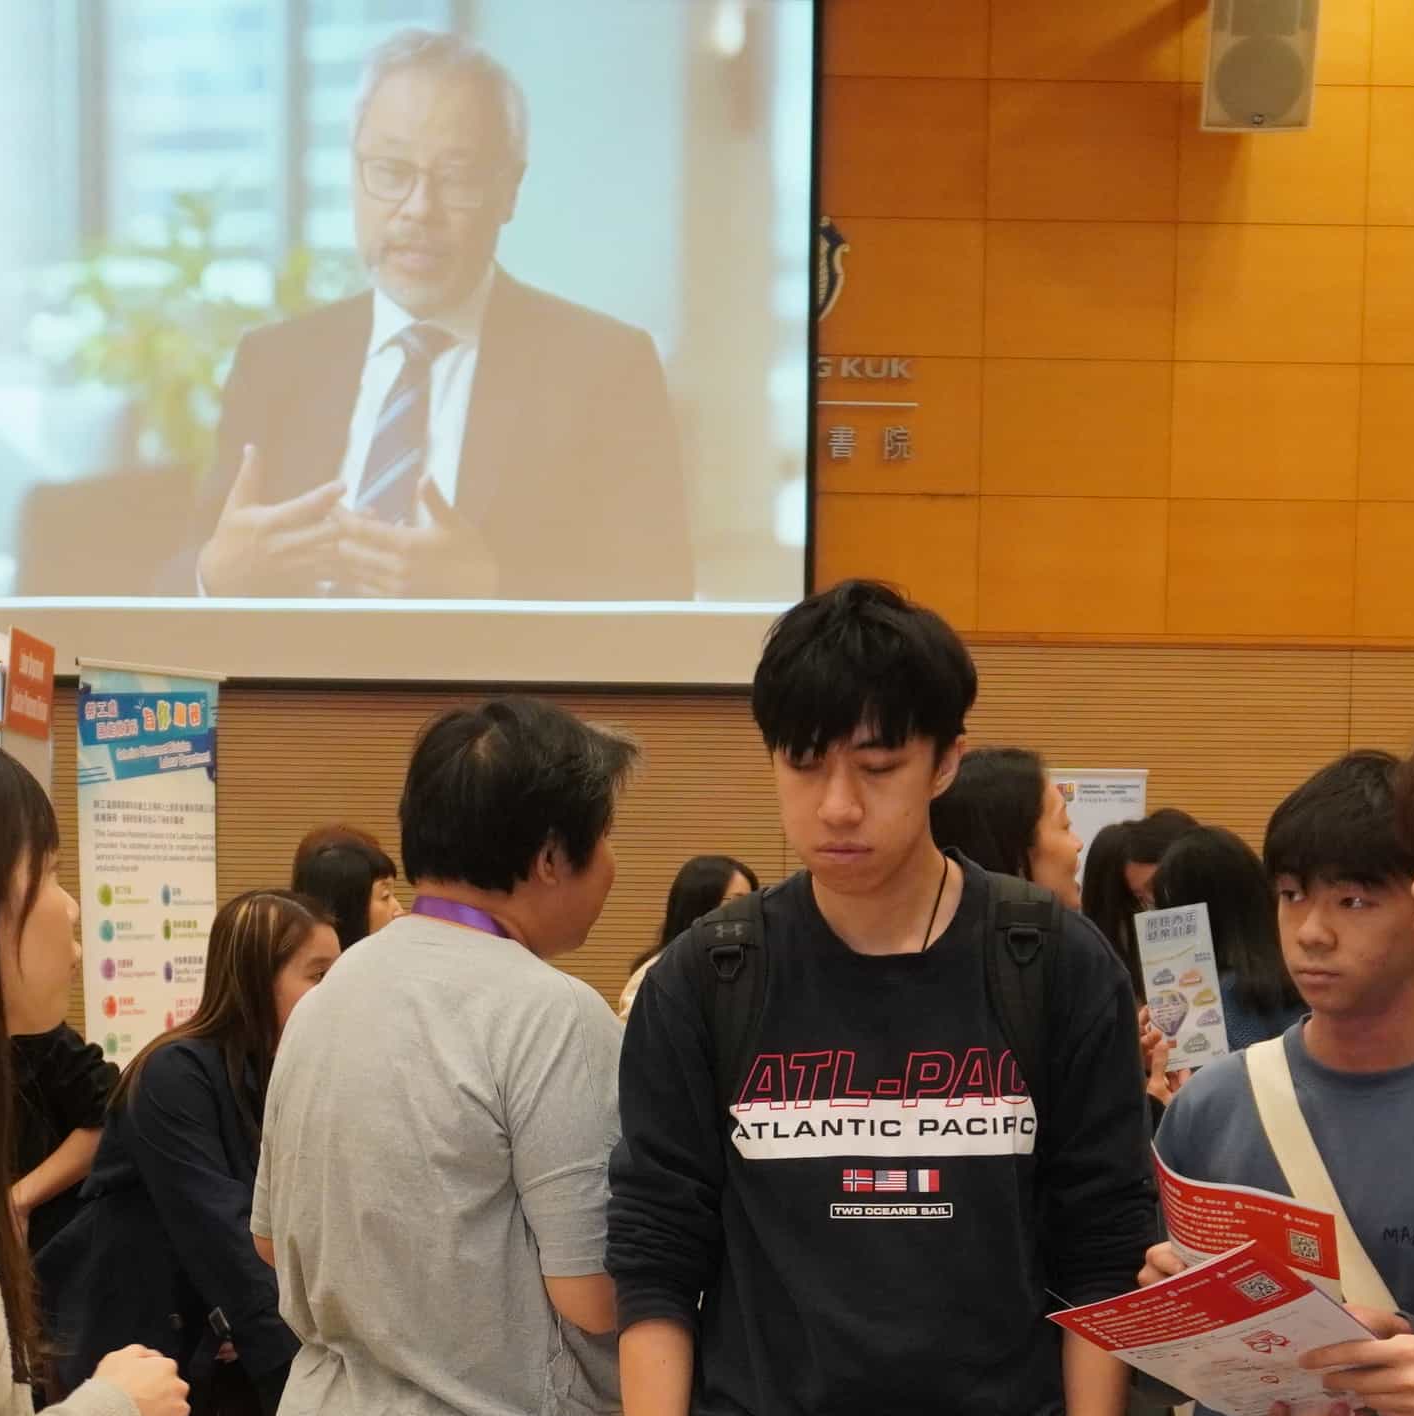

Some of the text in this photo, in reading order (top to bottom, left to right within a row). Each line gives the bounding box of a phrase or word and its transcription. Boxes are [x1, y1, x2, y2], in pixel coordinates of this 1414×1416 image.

[841, 357, 915, 379] KUK
[736, 1115, 1035, 1140] ATLANTIC PACIFC
[834, 1207, 949, 1215] TWO OCEANS SAIL
